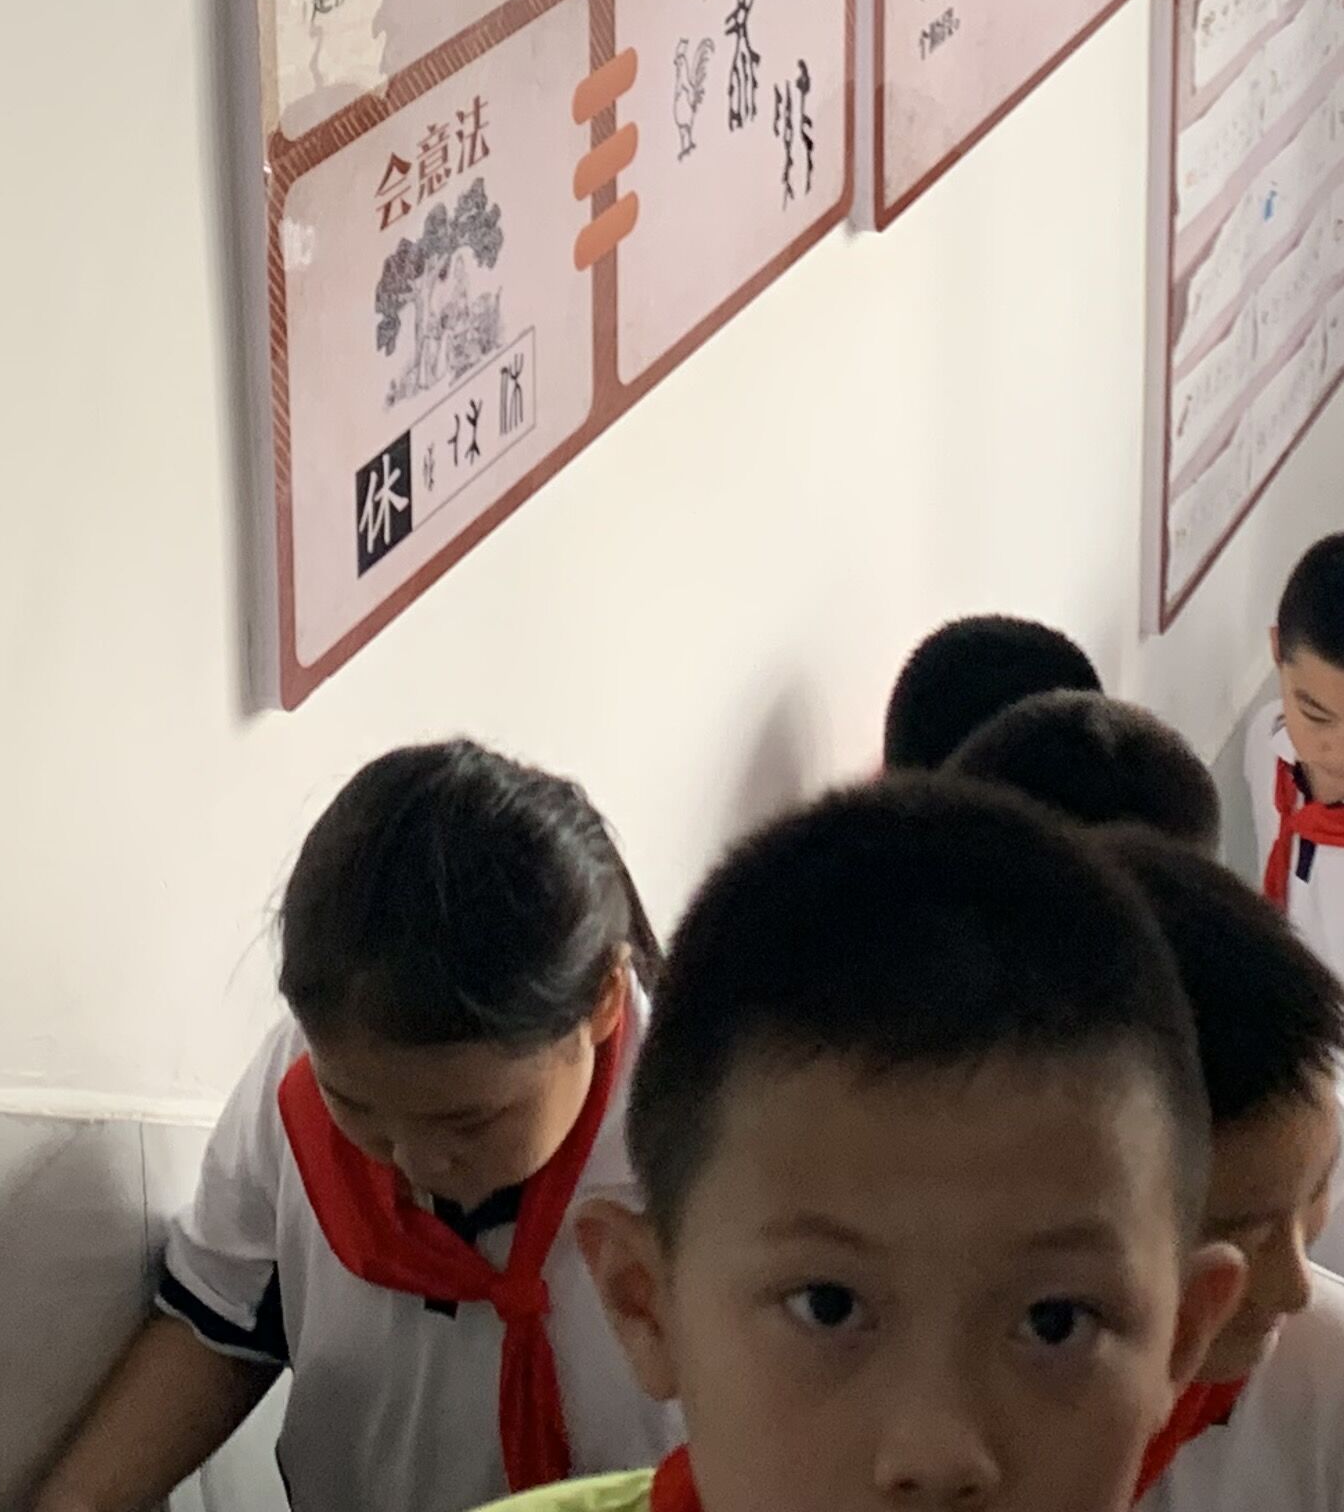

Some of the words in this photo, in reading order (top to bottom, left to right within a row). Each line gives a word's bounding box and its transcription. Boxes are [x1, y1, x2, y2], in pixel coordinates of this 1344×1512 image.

[375, 95, 490, 230] 会意法
[358, 454, 410, 554] 休
